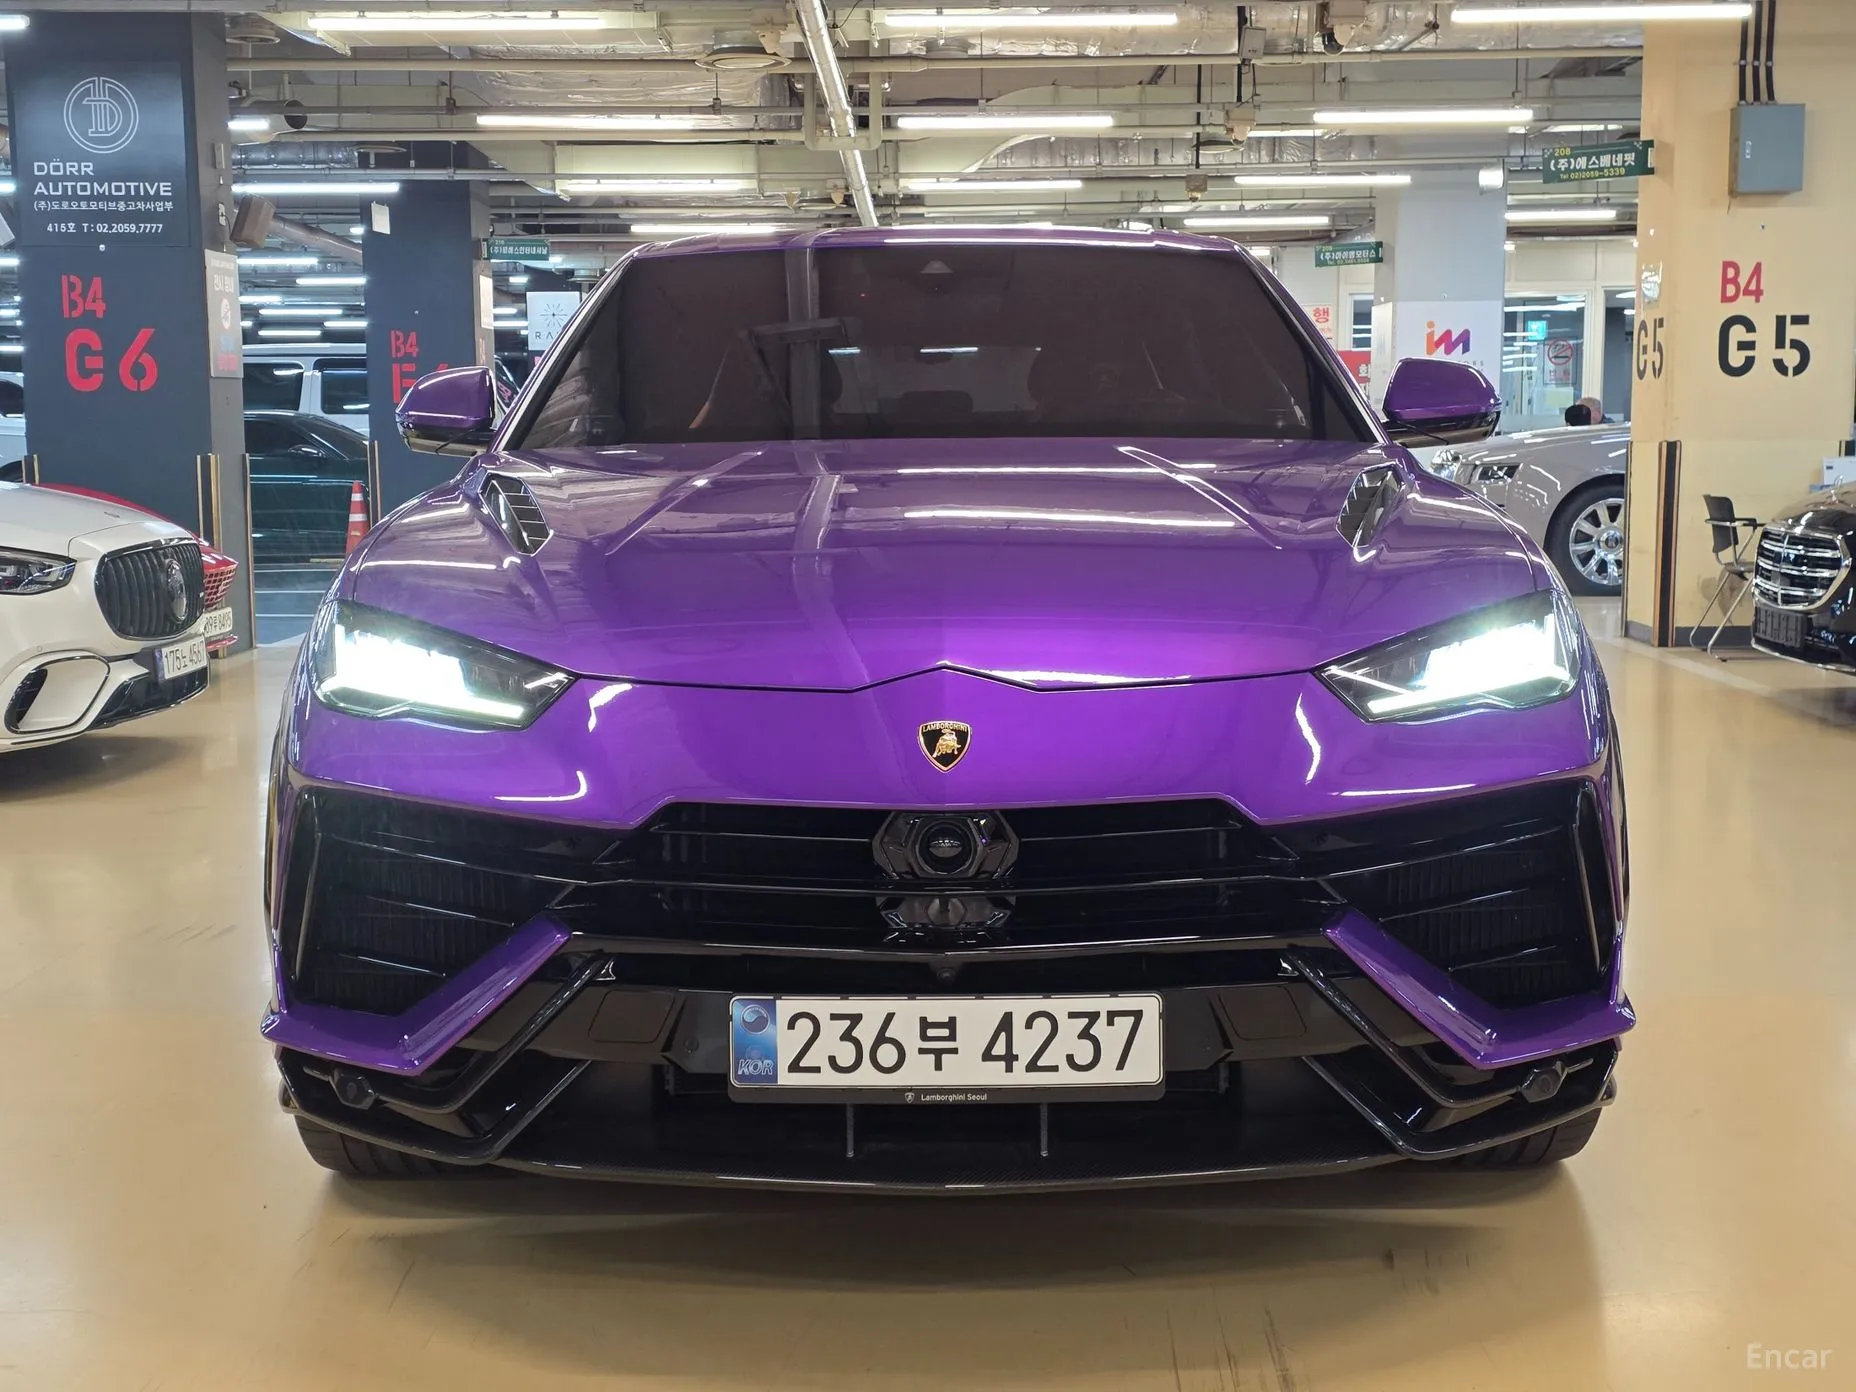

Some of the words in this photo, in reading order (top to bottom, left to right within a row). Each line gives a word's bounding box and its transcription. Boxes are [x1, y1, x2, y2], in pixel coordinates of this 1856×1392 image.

[1554, 147, 1571, 157] 208
[33, 158, 95, 176] DÖRR
[1550, 152, 1635, 171] (주)에스베네핏
[33, 182, 173, 197] AUTOMOTIVE
[1720, 260, 1764, 303] B4
[61, 274, 106, 318] B4
[390, 330, 419, 358] B4
[981, 1009, 1144, 1074] 4237
[738, 1058, 774, 1075] KOR
[921, 1092, 966, 1102] Lamborghini
[967, 1093, 987, 1102] Seoul
